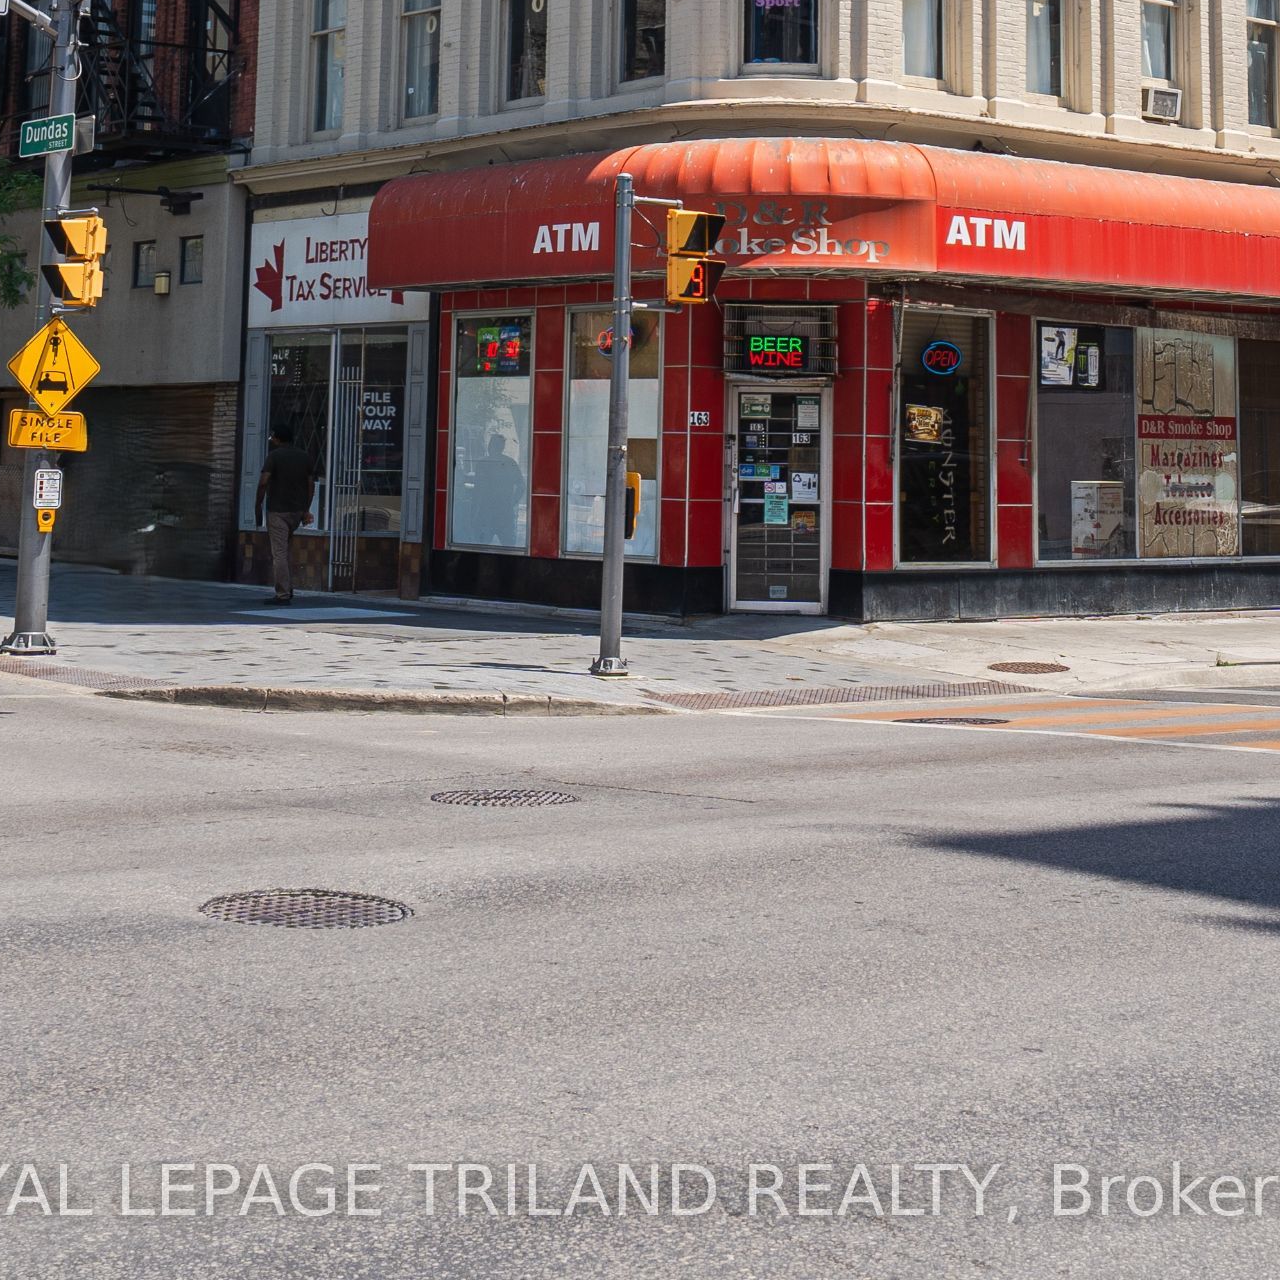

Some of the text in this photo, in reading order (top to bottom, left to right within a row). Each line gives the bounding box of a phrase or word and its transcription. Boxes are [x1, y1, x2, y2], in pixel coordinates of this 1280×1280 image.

[25, 121, 68, 144] Dundas
[48, 139, 67, 149] STREET
[532, 221, 600, 254] ATM
[945, 215, 1026, 251] ATM
[305, 236, 369, 264] LIBERTY
[791, 227, 890, 263] Shop
[285, 274, 316, 302] TAX
[690, 264, 704, 297] 9
[750, 336, 802, 352] BEER
[749, 351, 803, 367] WINE
[925, 350, 958, 366] OPEN
[363, 392, 391, 403] FILE
[357, 405, 396, 417] YOUR
[690, 412, 709, 425] 163
[20, 416, 73, 429] SINGLE
[362, 419, 392, 430] WAY.
[1141, 420, 1232, 438] D&R Smoke Shop
[30, 431, 61, 443] FILE
[793, 433, 810, 443] 163
[1154, 502, 1224, 526] Accessories
